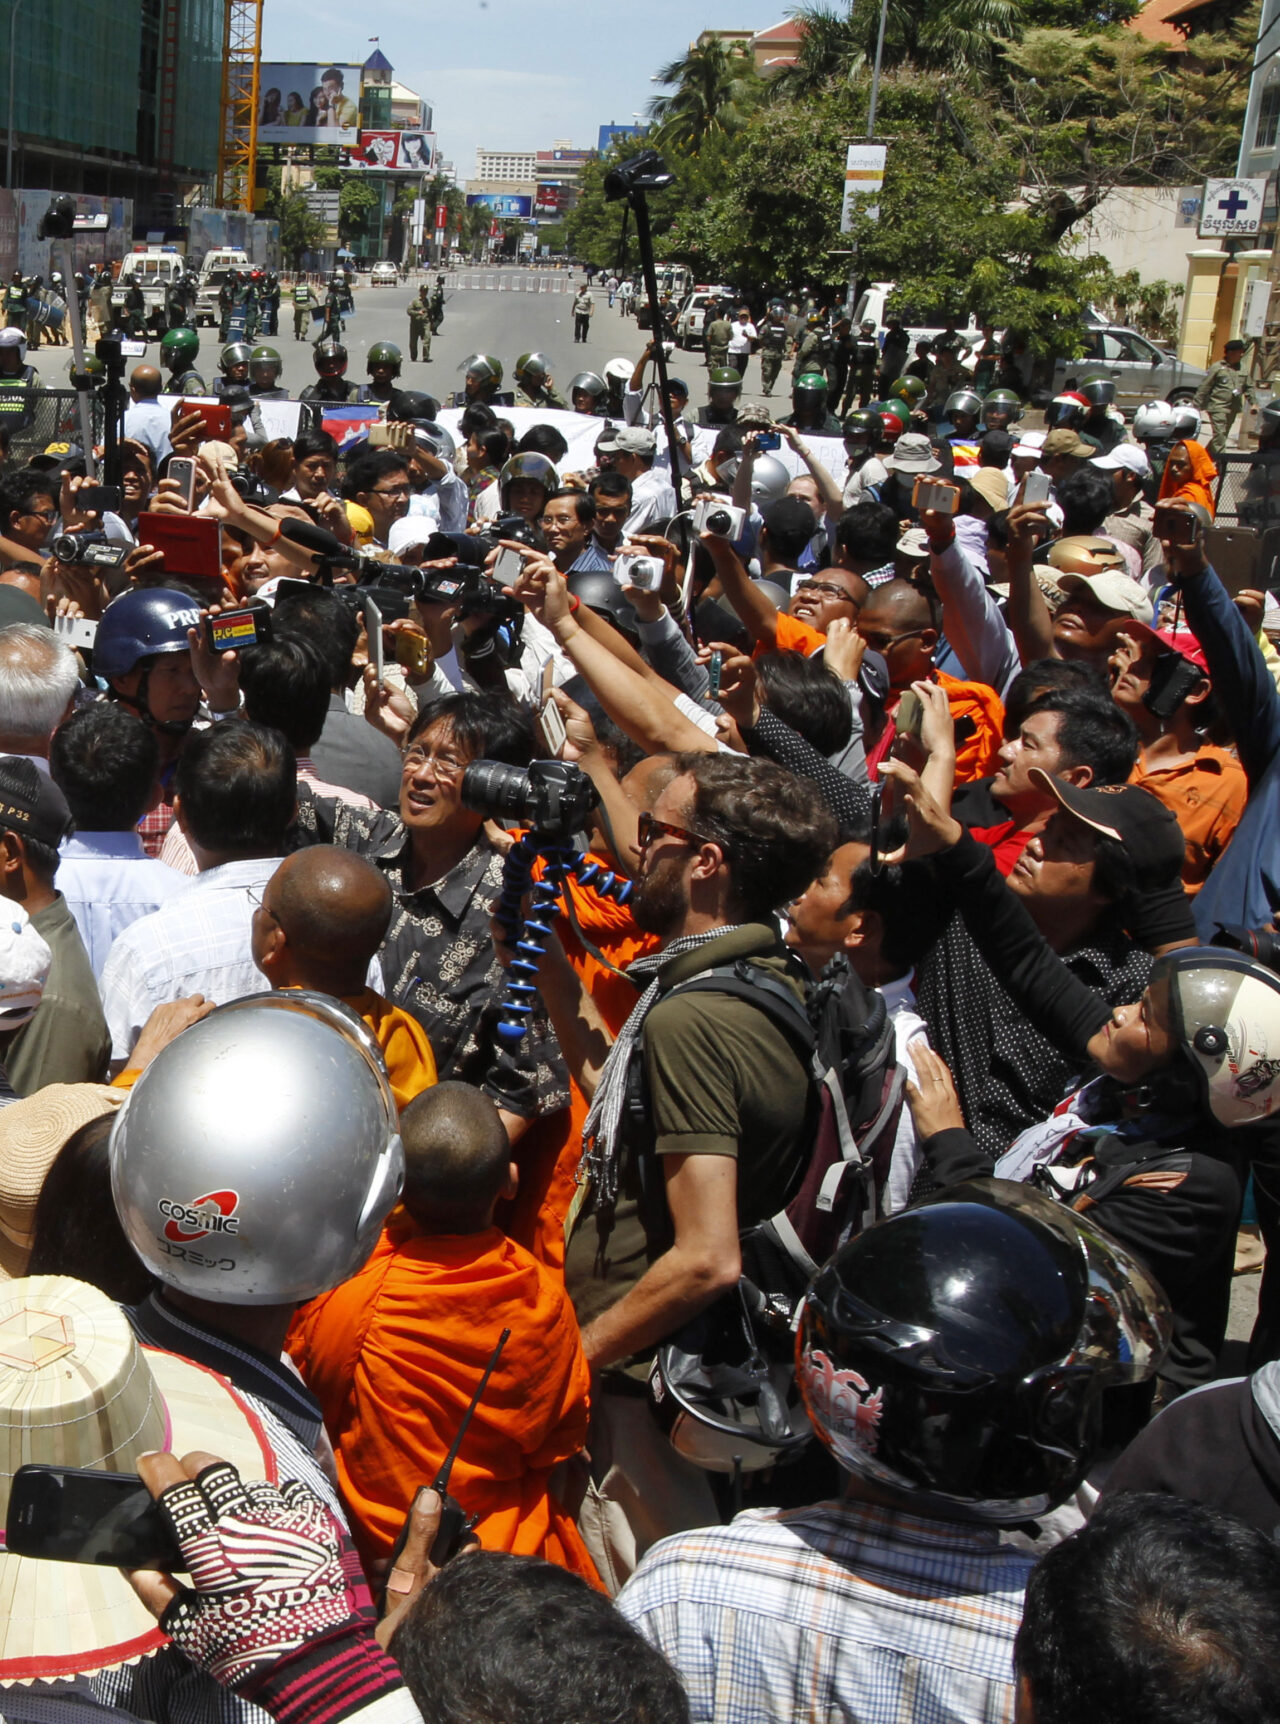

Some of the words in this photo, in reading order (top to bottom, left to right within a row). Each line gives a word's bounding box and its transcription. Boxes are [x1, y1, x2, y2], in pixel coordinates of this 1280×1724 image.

[168, 608, 202, 630] PRE
[16, 810, 30, 822] 32
[158, 1237, 237, 1273] コスミック
[199, 1584, 336, 1621] HONDA
